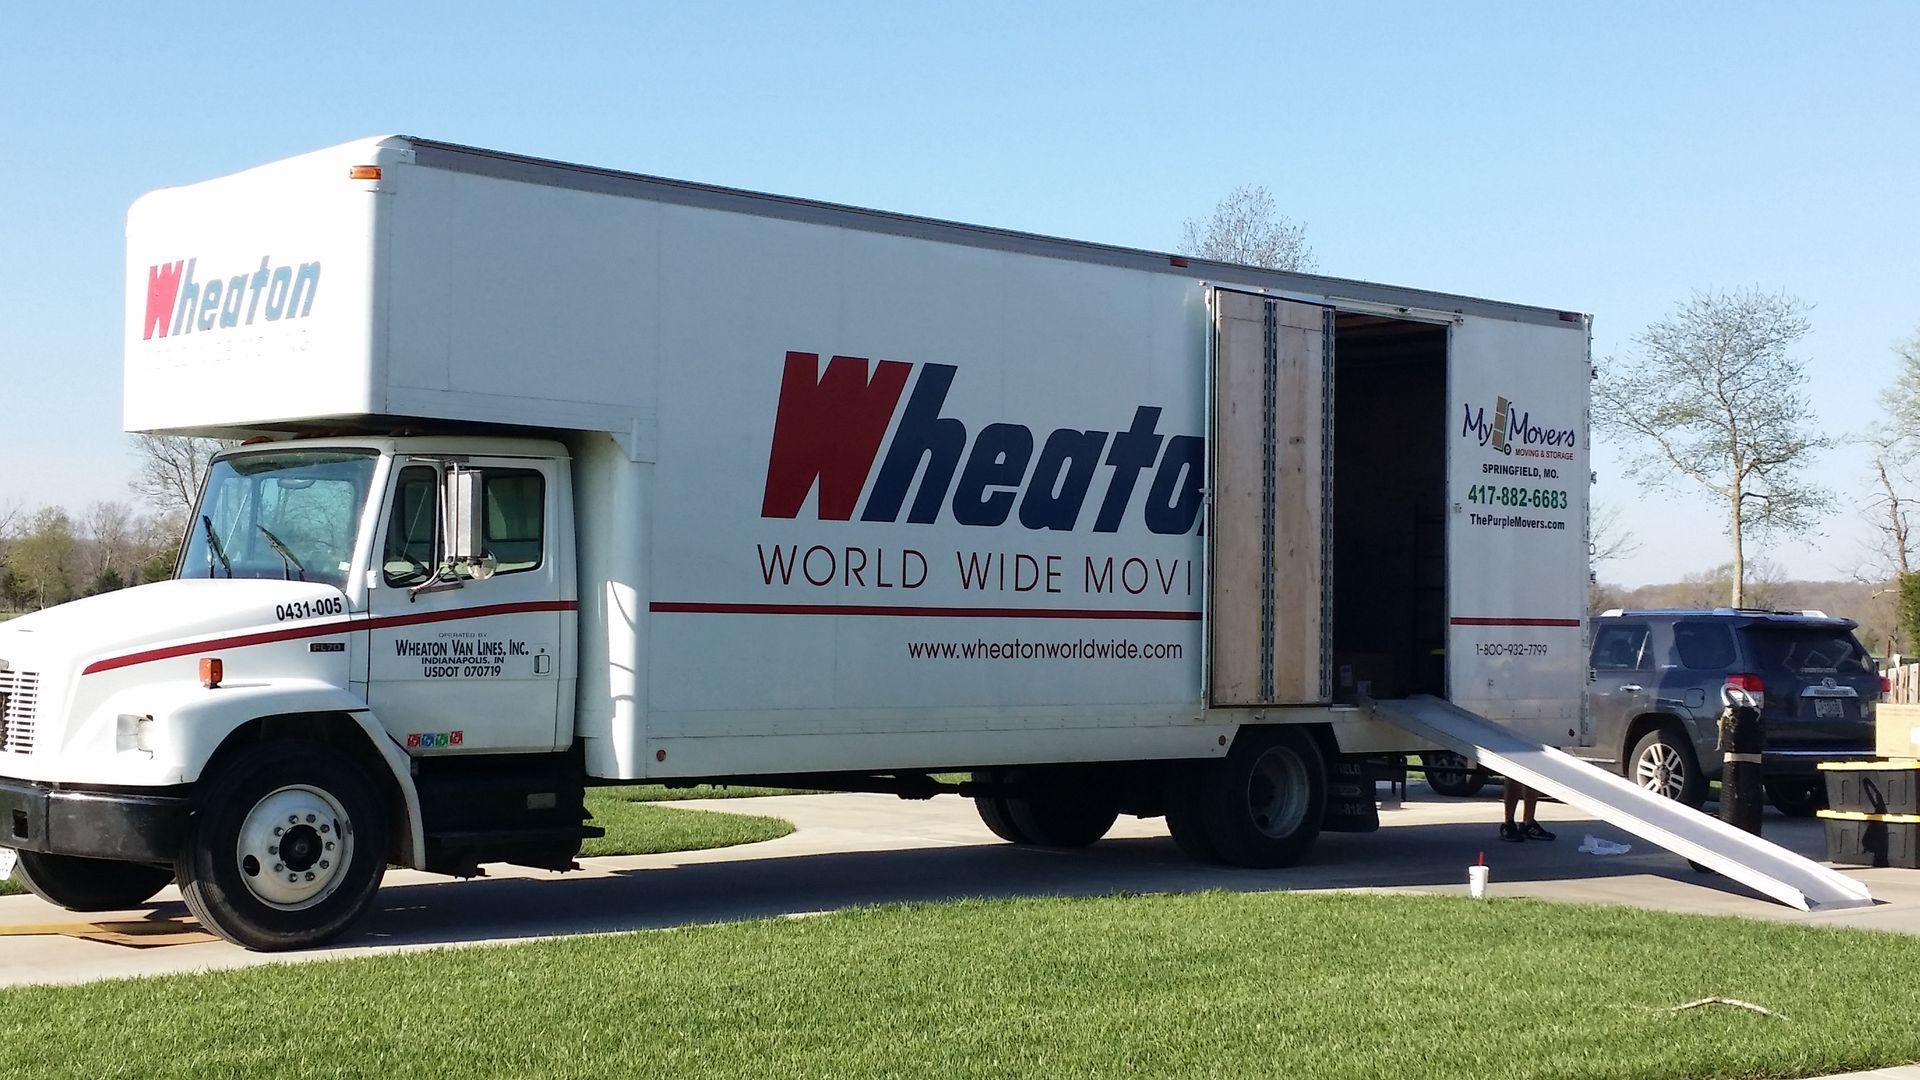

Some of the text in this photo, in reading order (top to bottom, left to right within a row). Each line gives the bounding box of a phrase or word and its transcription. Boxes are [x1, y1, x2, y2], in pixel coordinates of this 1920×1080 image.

[143, 255, 321, 340] Wheaton
[1462, 403, 1575, 448] My Movers
[761, 351, 1206, 536] Wheato
[1515, 448, 1540, 458] MOVING
[1546, 451, 1574, 461] STORAGE
[1482, 463, 1559, 479] SPRINGFIELD, MO.
[1468, 484, 1568, 509] 417-882-6683
[1470, 513, 1565, 530] ThePurpleMovers.com
[757, 544, 928, 589] WORLD
[957, 551, 1063, 593] WIDE
[276, 597, 342, 621] 0431-005
[395, 639, 447, 656] WHEATON
[452, 639, 473, 656] VAN
[509, 639, 529, 655] INC.
[908, 638, 1183, 660] www.wheatonworldwide.com
[1476, 643, 1548, 656] 1-800-932-7799
[424, 665, 501, 677] USDOT 070719
